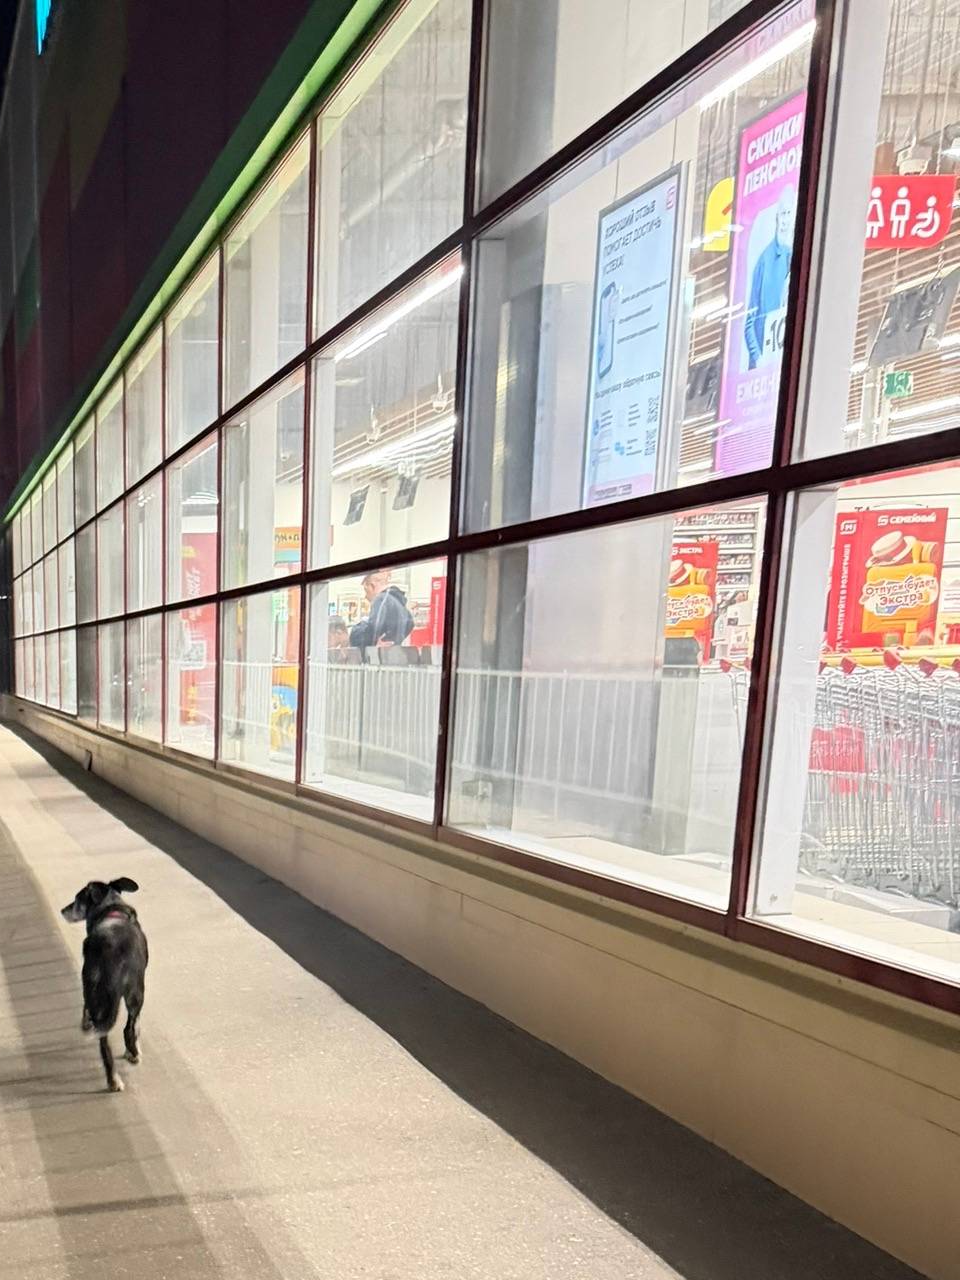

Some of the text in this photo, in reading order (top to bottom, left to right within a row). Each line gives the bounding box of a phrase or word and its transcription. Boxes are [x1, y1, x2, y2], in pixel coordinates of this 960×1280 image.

[747, 112, 803, 164] СКИДКИ
[866, 584, 904, 595] Отпуск
[880, 593, 923, 606] Экстра
